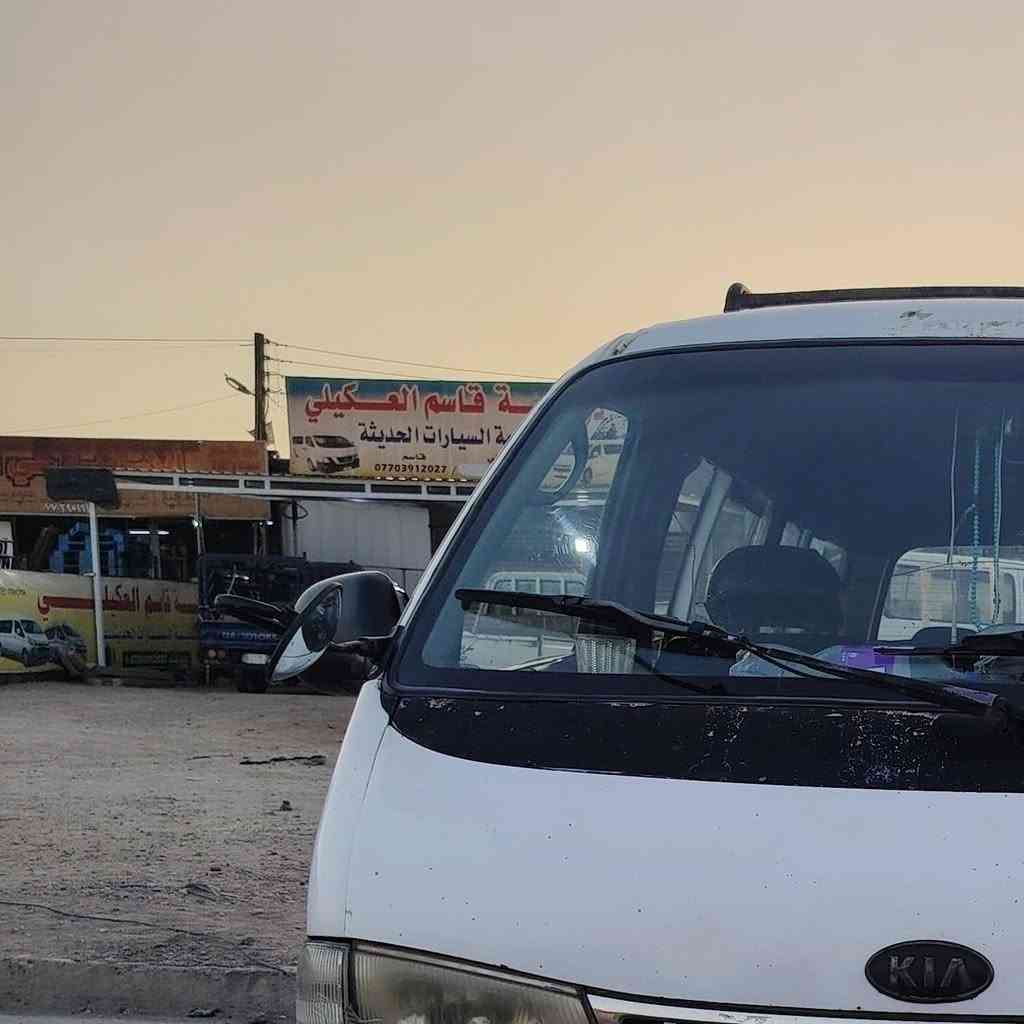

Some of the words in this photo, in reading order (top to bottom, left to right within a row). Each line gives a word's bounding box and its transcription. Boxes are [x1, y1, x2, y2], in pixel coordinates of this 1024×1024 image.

[424, 382, 485, 419] قاسم
[358, 421, 419, 449] الحديثة
[423, 426, 491, 450] السيارات
[887, 955, 971, 990] KIA
